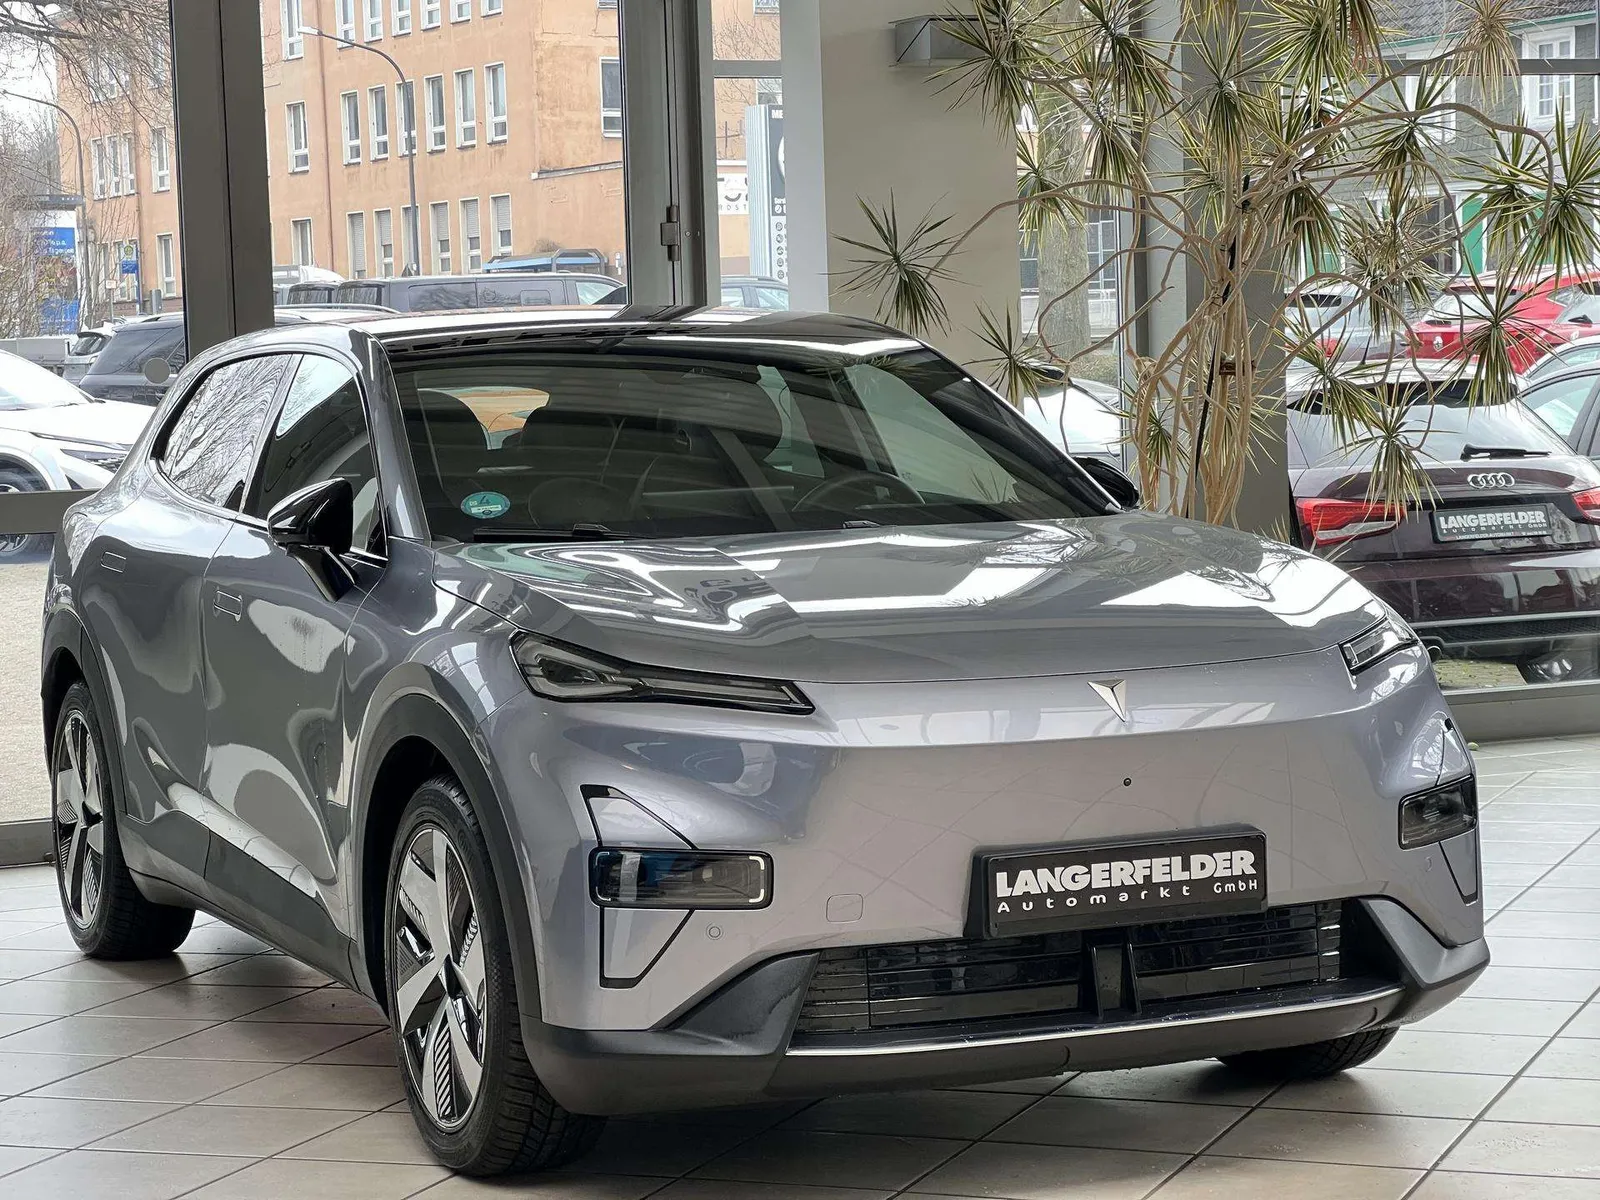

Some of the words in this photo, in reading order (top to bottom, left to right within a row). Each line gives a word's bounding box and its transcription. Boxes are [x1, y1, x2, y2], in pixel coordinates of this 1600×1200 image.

[1439, 510, 1546, 529] LANGERFELDER
[996, 850, 1257, 898] LANGERFELDER
[997, 885, 1190, 914] Automarkt
[1213, 878, 1258, 894] GmbH
